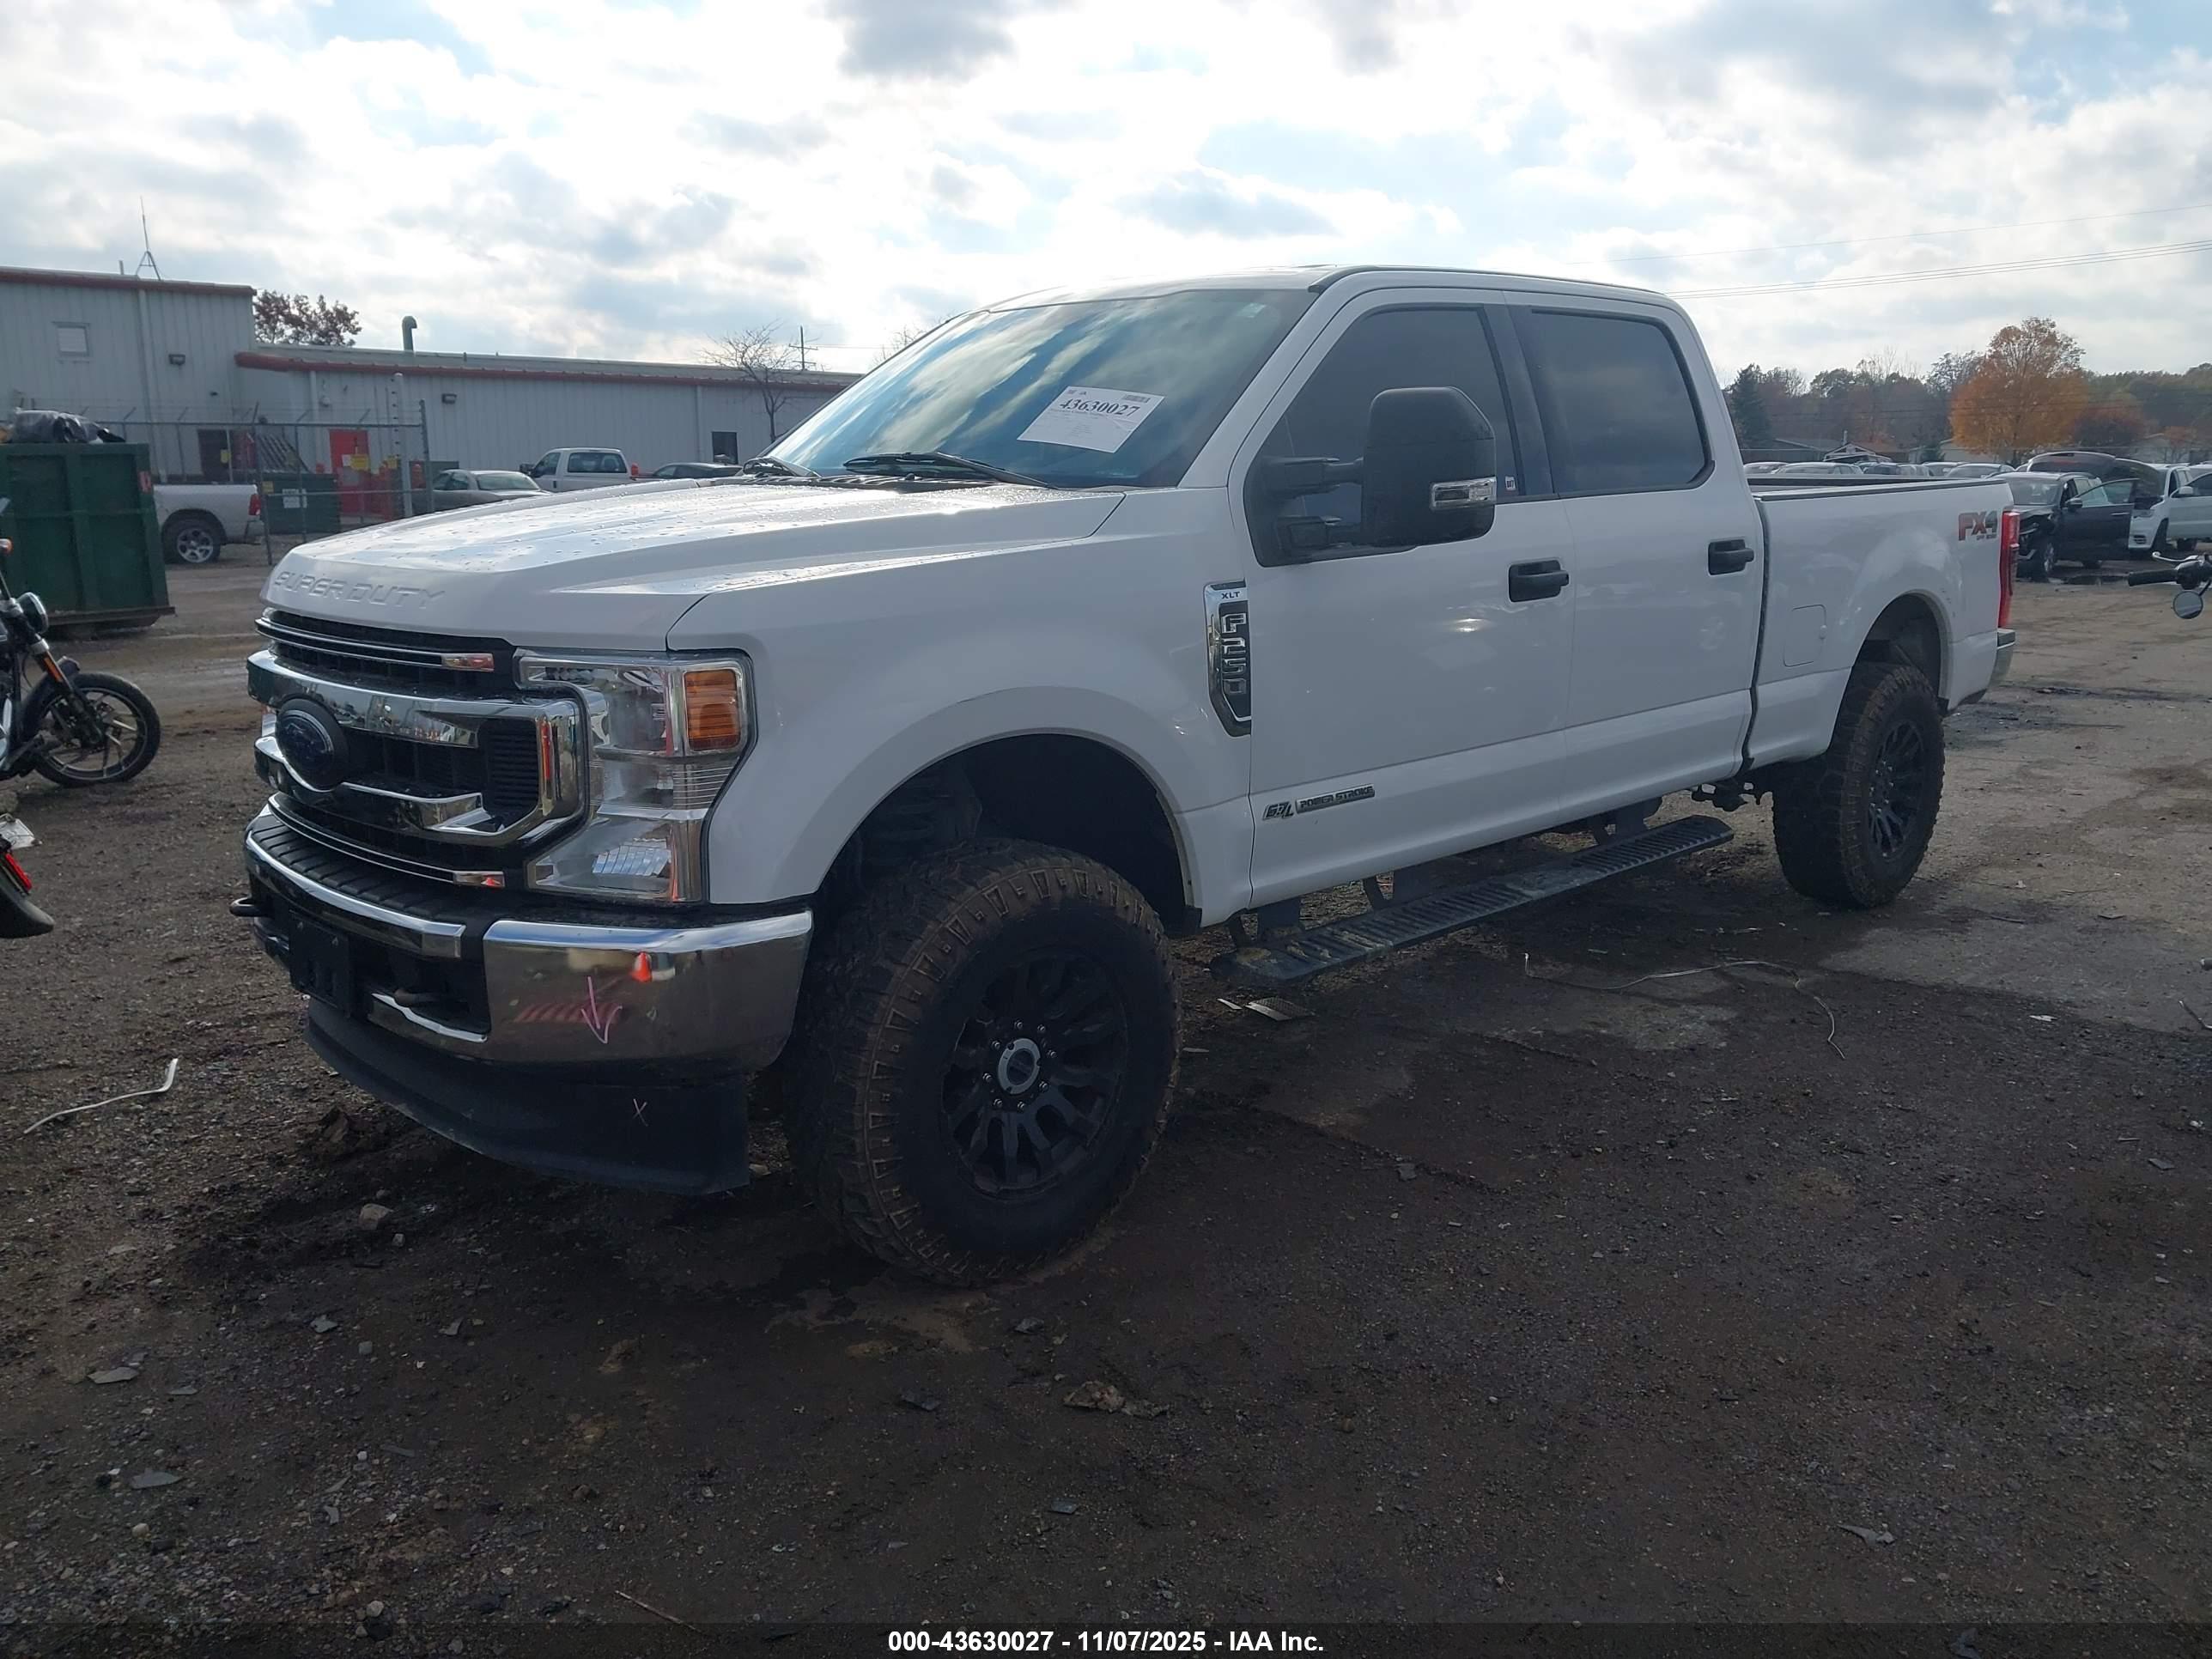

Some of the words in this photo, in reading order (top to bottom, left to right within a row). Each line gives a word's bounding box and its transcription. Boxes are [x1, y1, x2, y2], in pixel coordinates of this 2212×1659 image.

[1059, 398, 1140, 416] 43630027
[1959, 510, 1998, 541] FX4
[275, 571, 347, 600] SUPER
[346, 583, 445, 610] DUTY
[1299, 794, 1334, 809] POWER
[1335, 786, 1374, 800] STROKE
